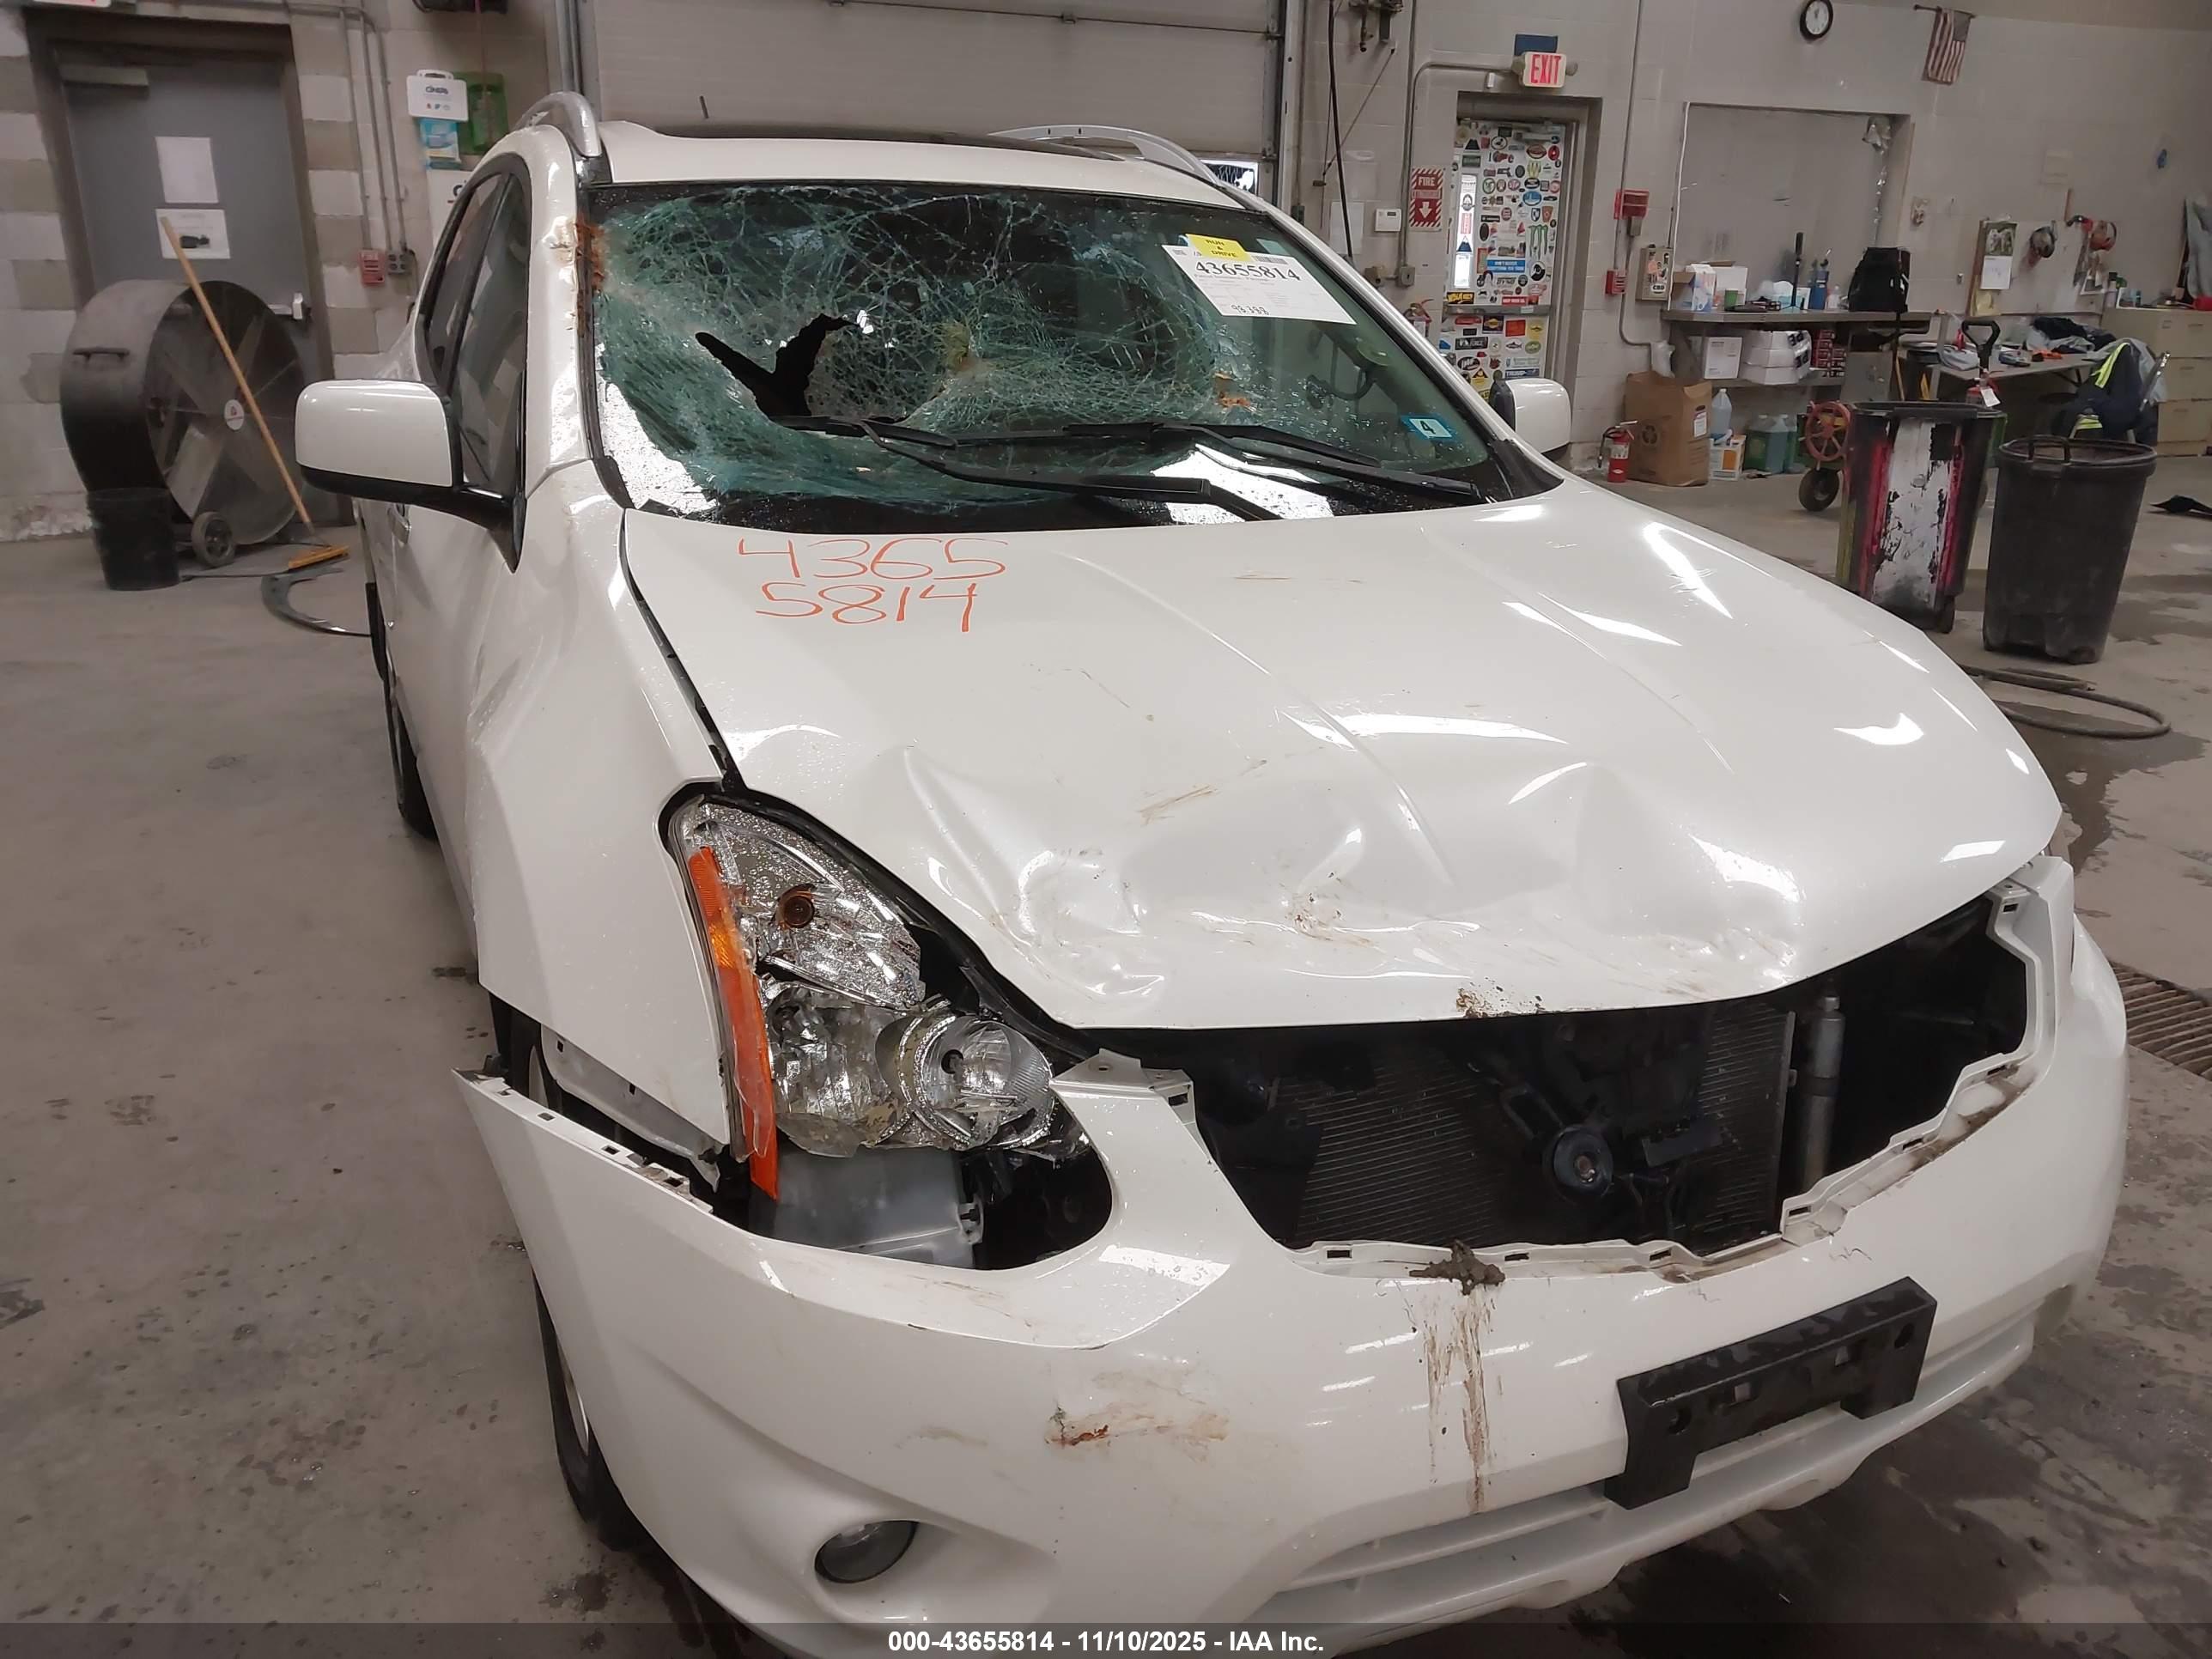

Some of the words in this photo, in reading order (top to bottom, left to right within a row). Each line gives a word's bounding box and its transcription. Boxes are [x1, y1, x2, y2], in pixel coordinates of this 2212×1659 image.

[1530, 54, 1561, 84] EXIT
[1418, 176, 1437, 186] FIRE
[1196, 261, 1301, 281] 43655814
[738, 538, 1009, 580] 4365
[755, 581, 977, 633] 5814
